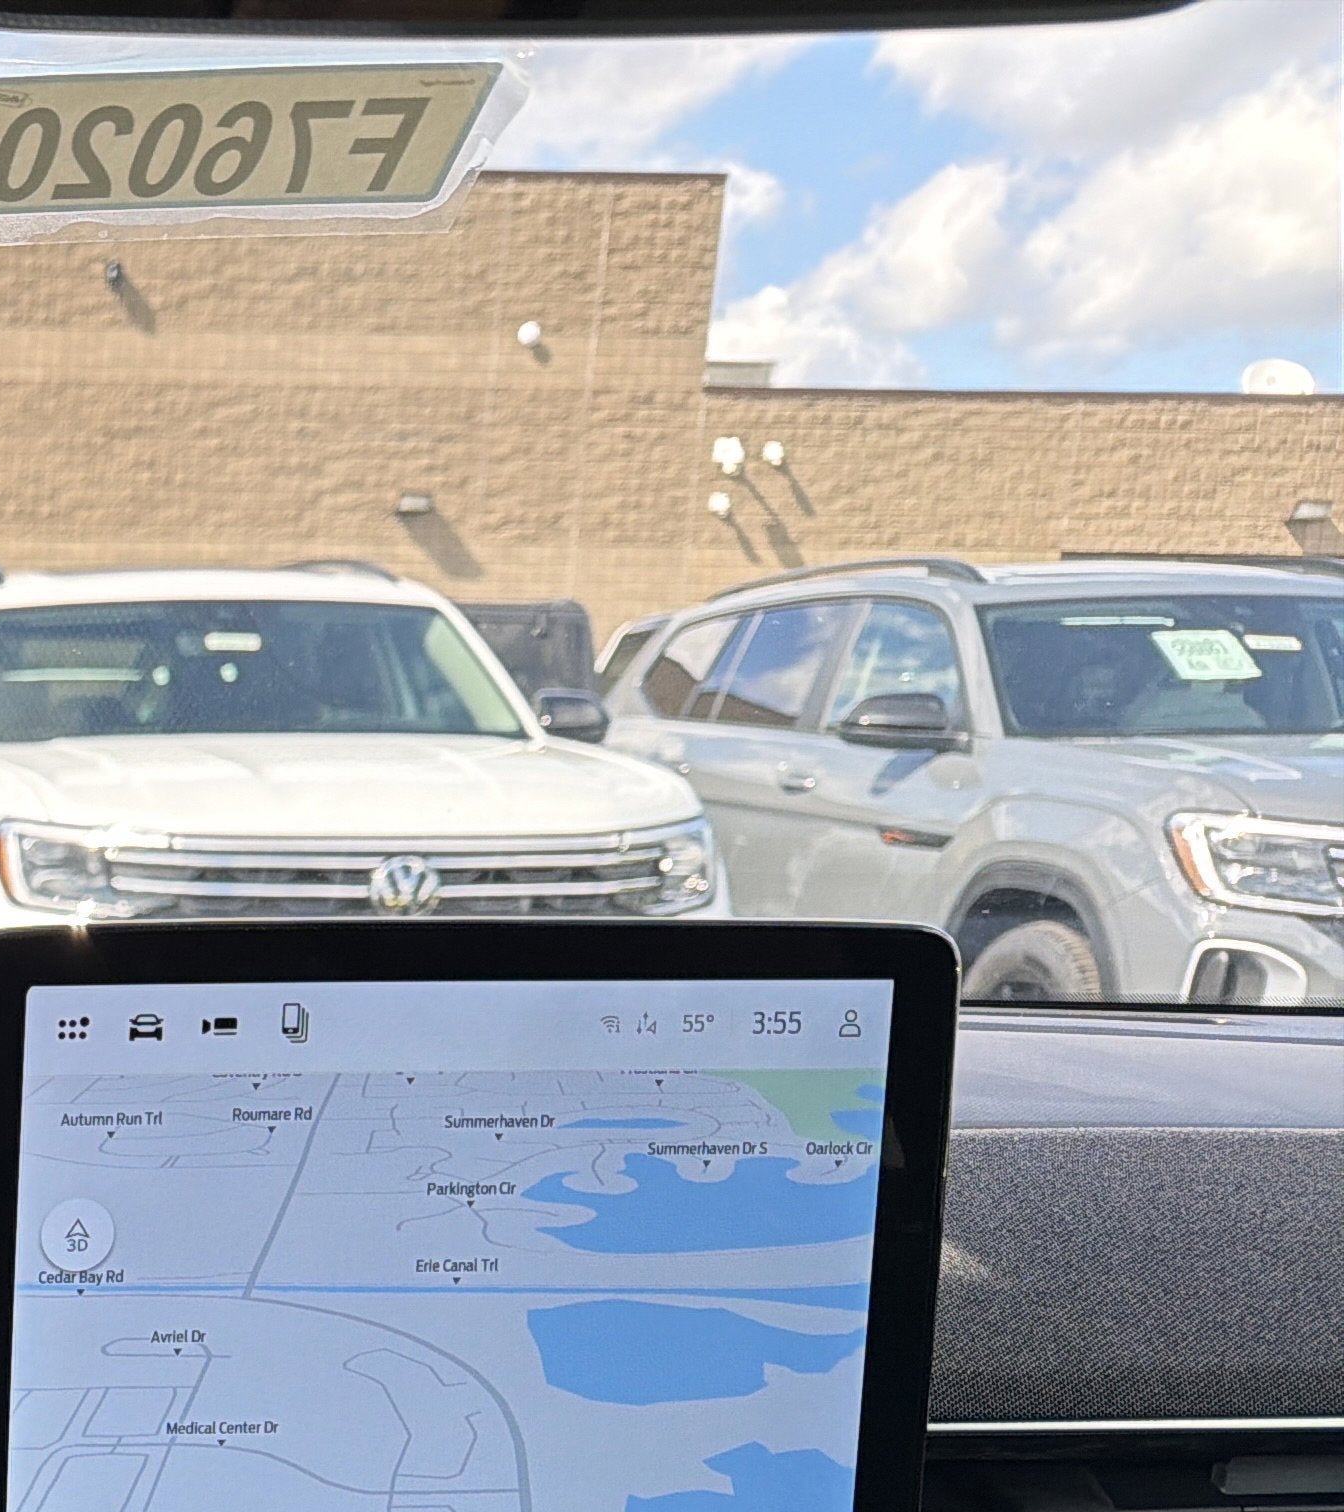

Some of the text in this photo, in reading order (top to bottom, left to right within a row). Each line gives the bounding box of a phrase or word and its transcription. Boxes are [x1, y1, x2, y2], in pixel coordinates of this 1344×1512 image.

[752, 1011, 802, 1035] 3:55
[60, 1111, 163, 1127] Autumn Run Trl
[232, 1106, 313, 1121] Roumare Rd
[444, 1113, 555, 1129] Summerhaven Dr
[647, 1141, 768, 1156] Summerhaven Dr S
[805, 1141, 853, 1156] Oarlock
[426, 1181, 497, 1199] Parkington
[66, 1238, 88, 1252] 3D
[415, 1257, 499, 1273] Erie Canal Trl
[38, 1268, 124, 1287] Cedar Bay Rd
[150, 1329, 206, 1345] Avriel Dr
[166, 1420, 279, 1435] Medical Center Dr
